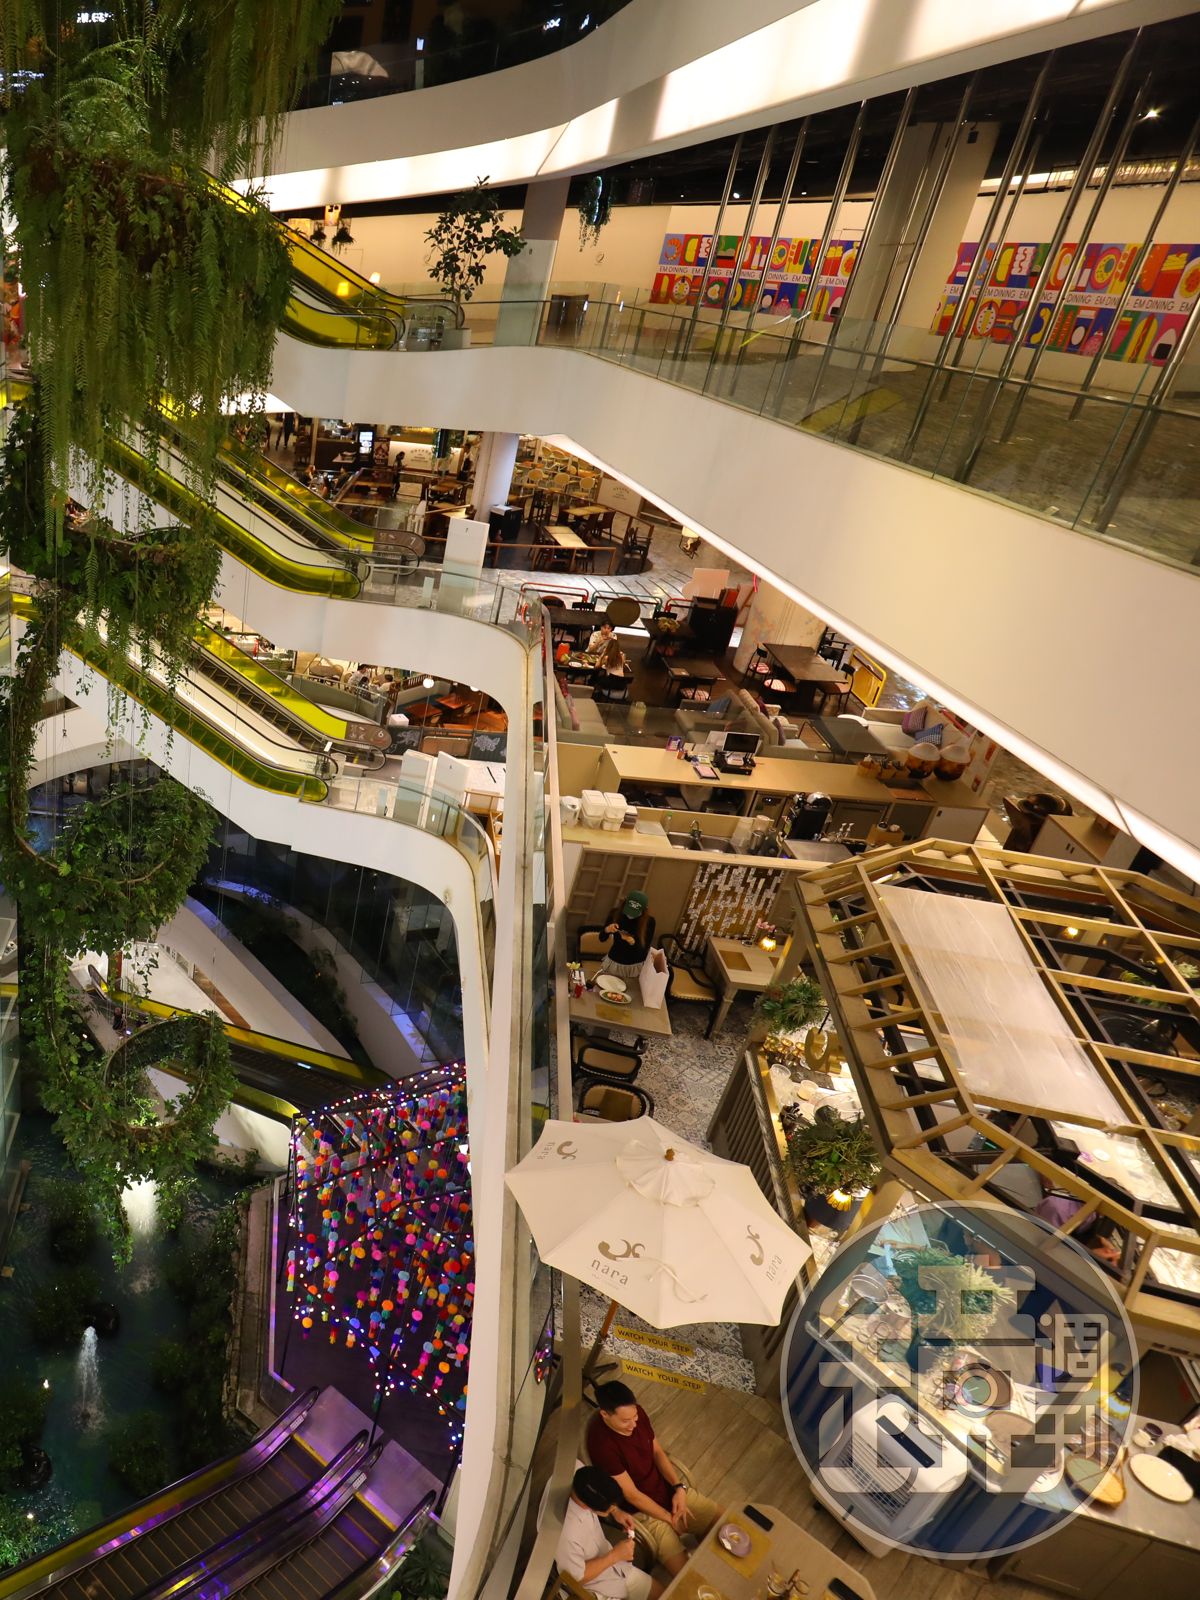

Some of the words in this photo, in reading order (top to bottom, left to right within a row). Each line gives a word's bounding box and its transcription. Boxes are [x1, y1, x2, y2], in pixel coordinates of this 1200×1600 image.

[994, 290, 1015, 298] DINING
[1067, 294, 1091, 303] DINING
[1133, 299, 1144, 308] EM
[1146, 301, 1174, 311] DINING
[377, 729, 384, 738] 6
[591, 1258, 629, 1286] nara
[766, 1254, 783, 1282] nara
[617, 1329, 644, 1342] WATCH
[648, 1337, 669, 1348] YOUR
[672, 1343, 690, 1353] STEP
[626, 1364, 654, 1377] WATCH
[657, 1373, 679, 1385] YOUR
[682, 1380, 702, 1391] STEP
